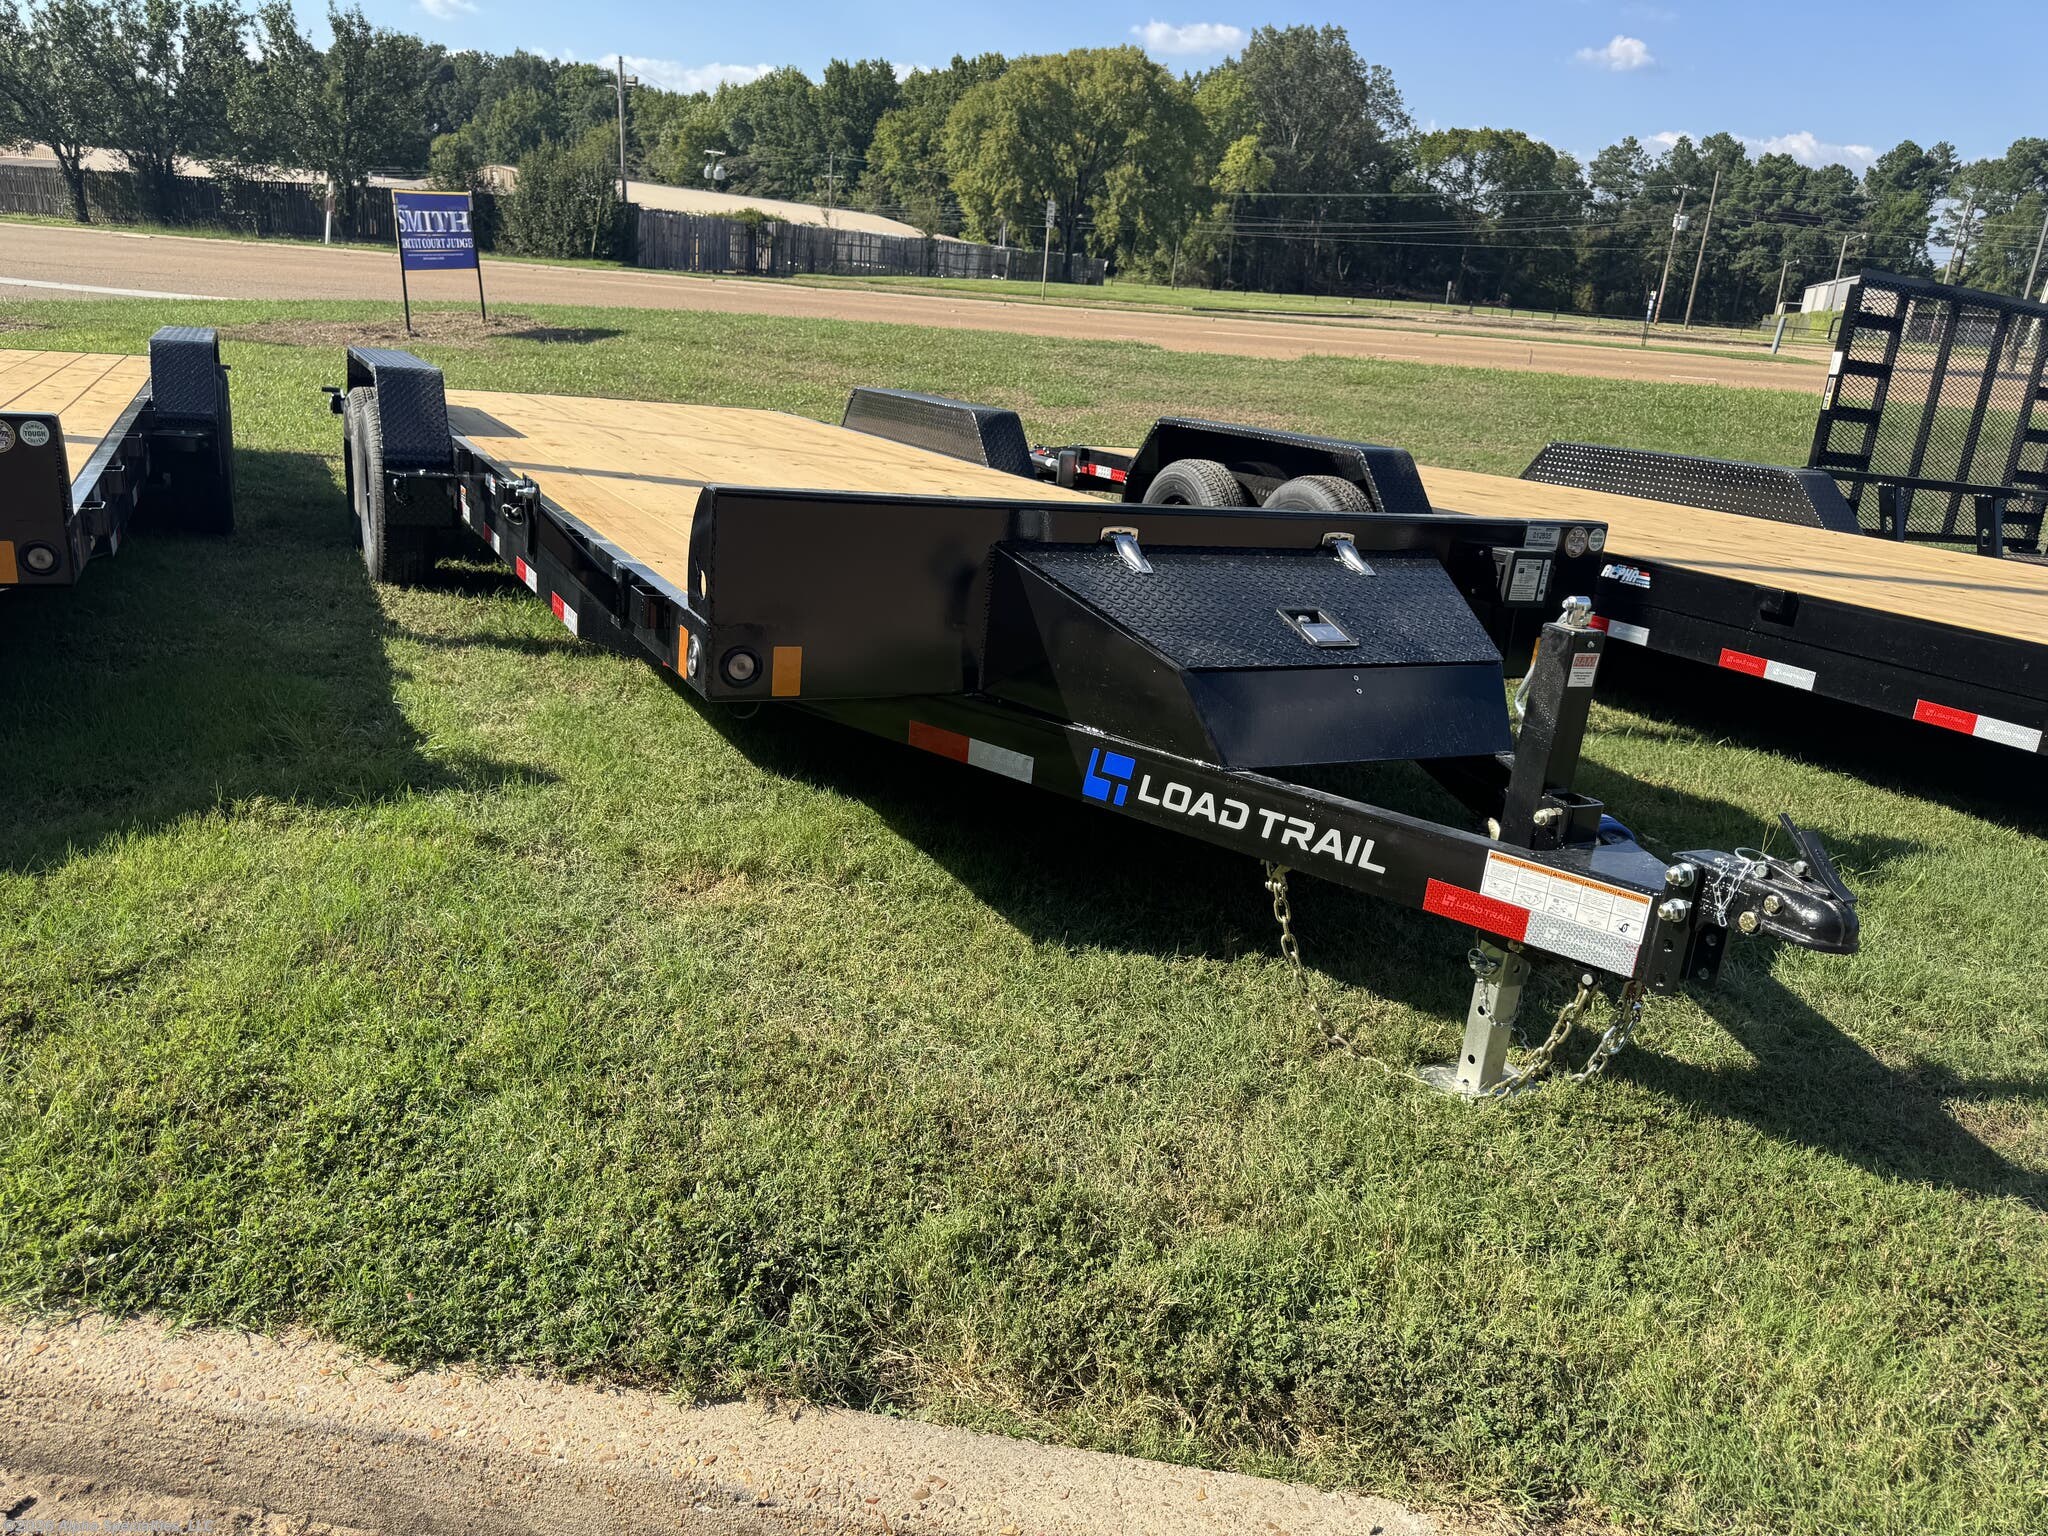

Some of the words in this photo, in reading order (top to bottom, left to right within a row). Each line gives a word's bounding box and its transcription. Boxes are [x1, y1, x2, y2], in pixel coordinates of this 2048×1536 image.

[398, 209, 472, 232] SMITH
[421, 238, 445, 249] COURT
[446, 237, 474, 249] JUDGE
[1137, 774, 1250, 830] LOAD
[1258, 808, 1386, 874] TRAIL
[1455, 900, 1483, 914] LOAD
[1484, 909, 1512, 923] TRAIL
